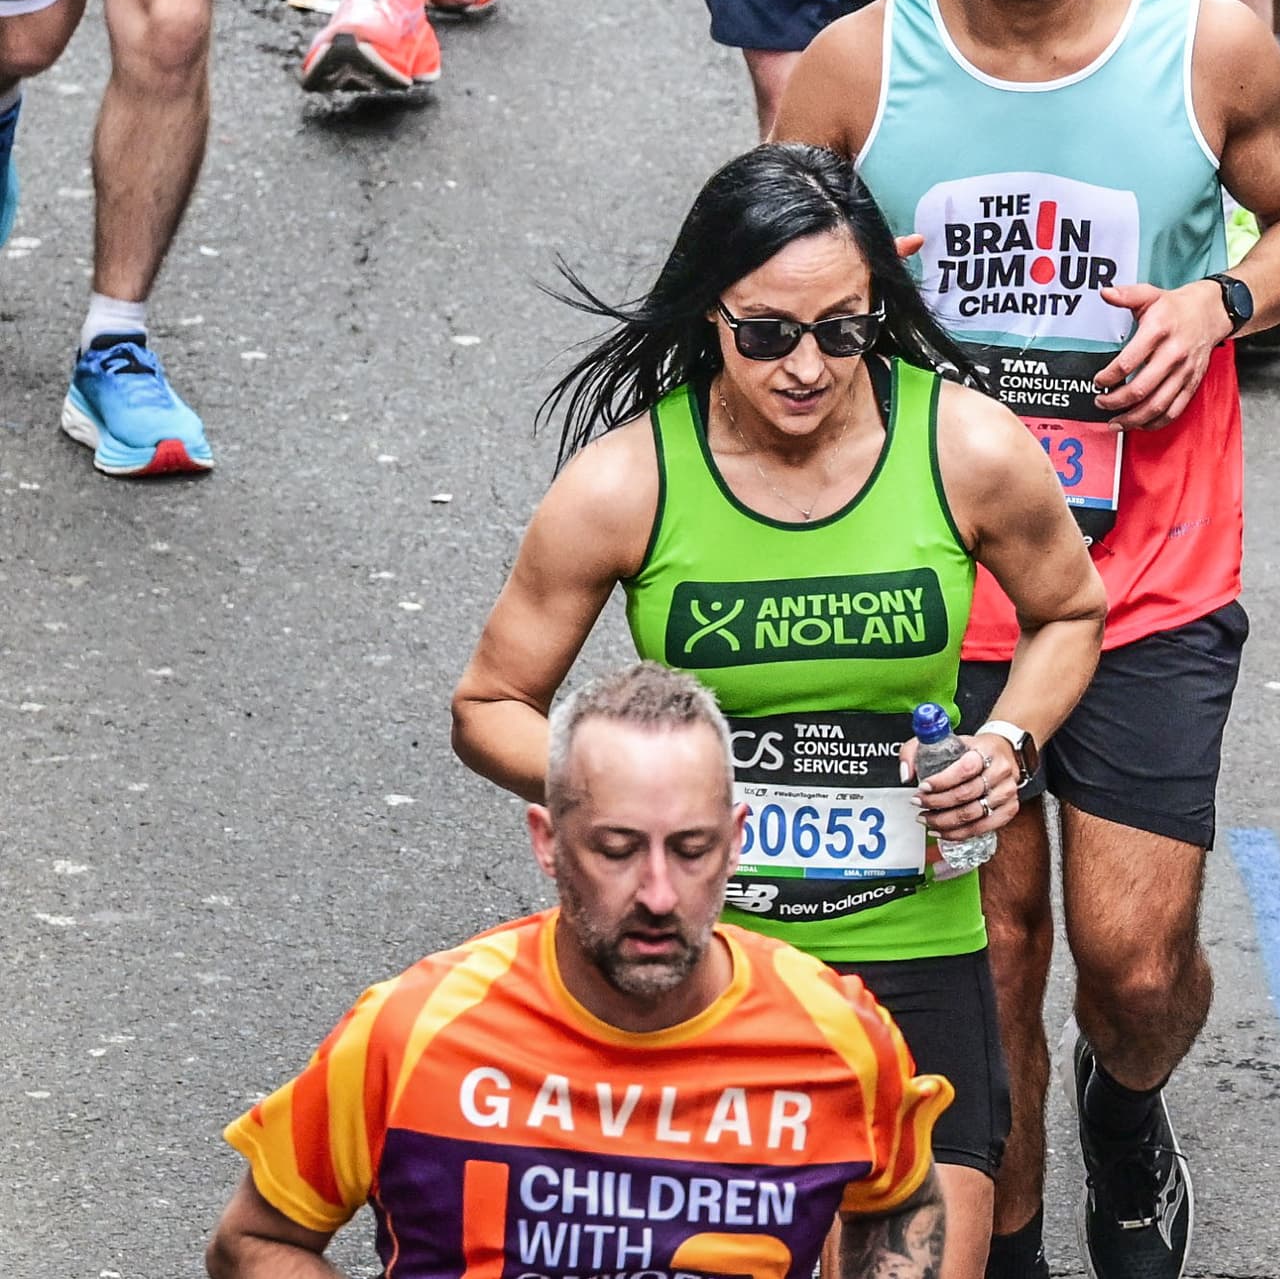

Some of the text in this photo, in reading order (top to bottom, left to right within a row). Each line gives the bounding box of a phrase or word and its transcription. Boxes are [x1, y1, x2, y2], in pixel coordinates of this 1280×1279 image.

[979, 193, 1031, 219] THE
[958, 292, 1083, 318] CHARITY
[1001, 358, 1049, 376] TATA
[999, 390, 1071, 408] SERVICES
[756, 587, 924, 620] ANTHONY
[754, 613, 927, 650] NOLAN
[793, 723, 845, 739] TATA
[730, 731, 785, 771] cs
[793, 741, 901, 758] CONSULTANC
[793, 758, 868, 775] SERVICES
[778, 902, 818, 916] new
[822, 883, 897, 914] balance
[459, 1066, 812, 1151] GAVLAR
[519, 1164, 796, 1226] CHILDREN
[517, 1219, 652, 1269] WITH
